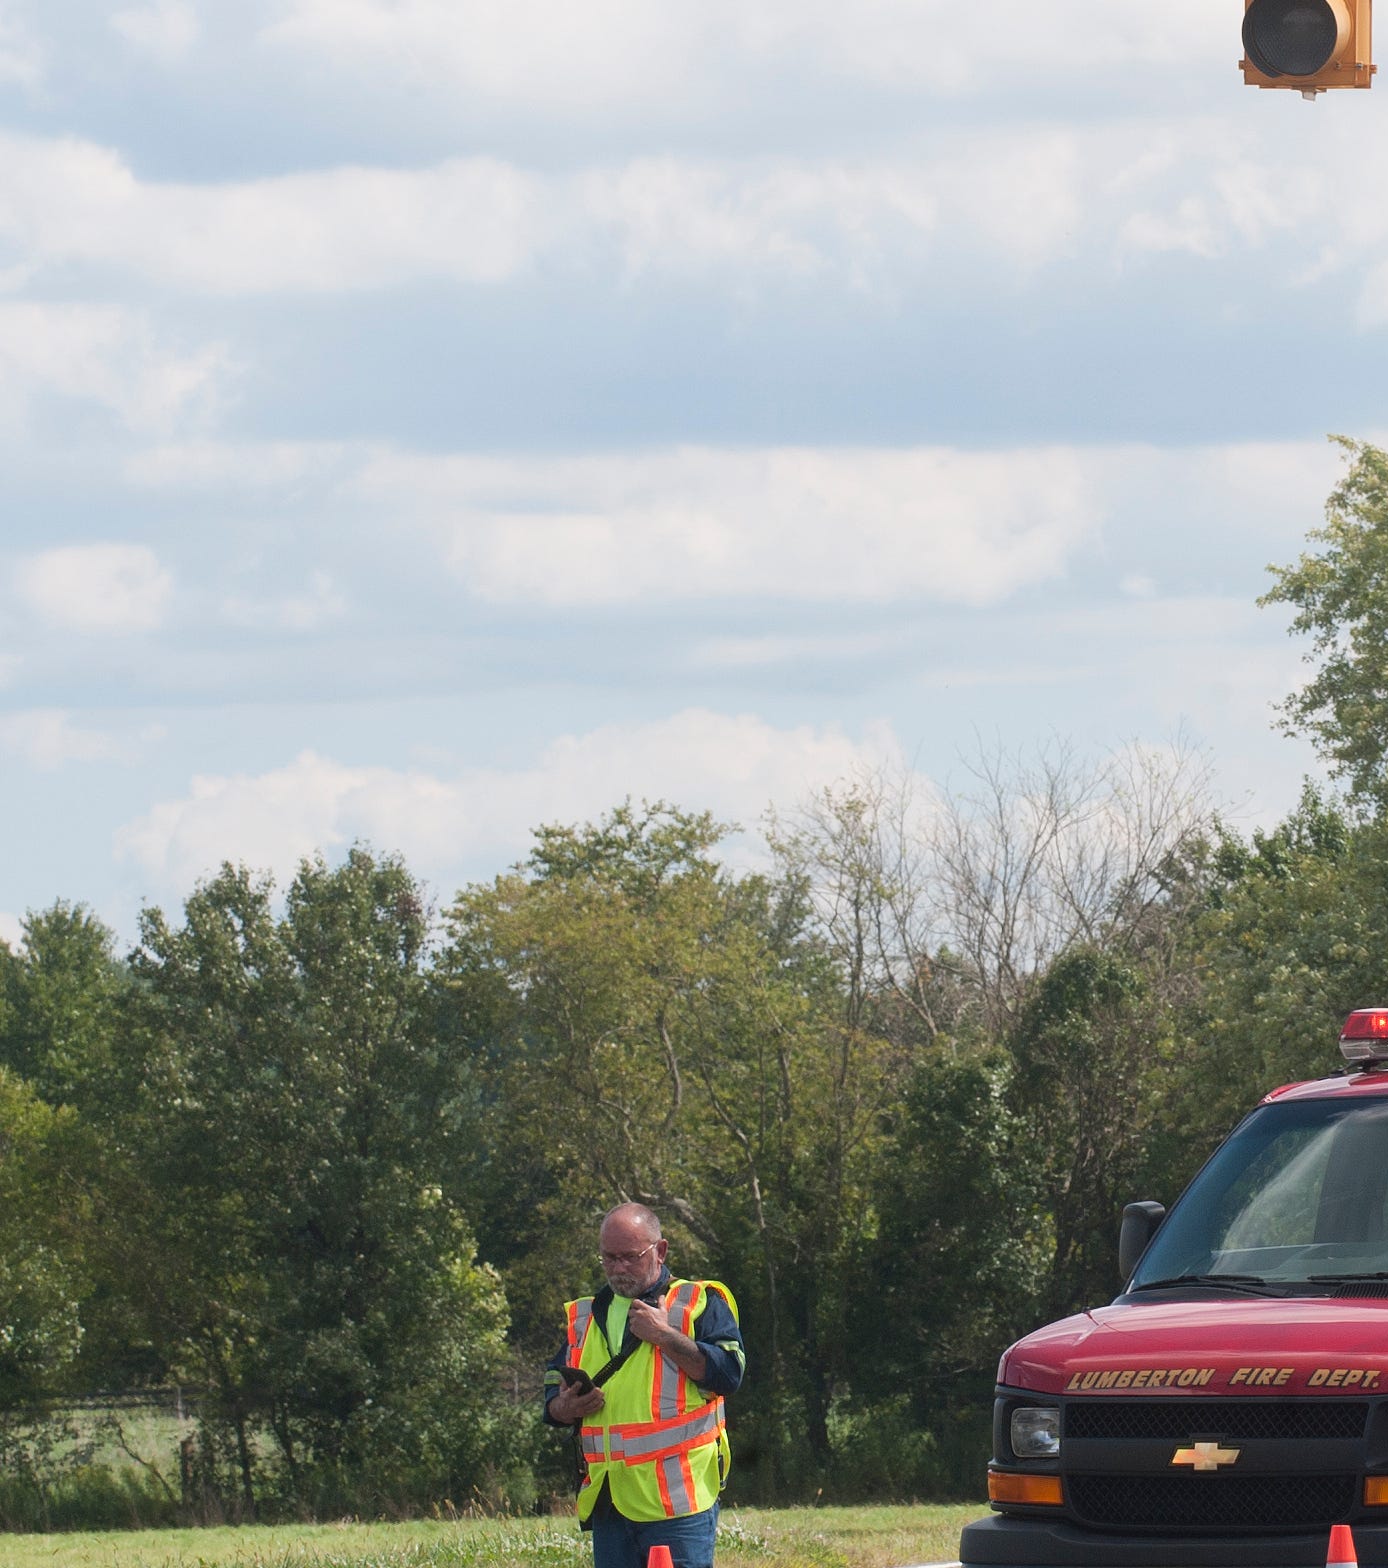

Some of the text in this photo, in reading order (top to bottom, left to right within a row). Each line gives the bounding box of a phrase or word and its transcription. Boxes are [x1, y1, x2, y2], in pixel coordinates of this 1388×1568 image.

[1066, 1367, 1381, 1391] LUMBERTON FIRE DEPT.
